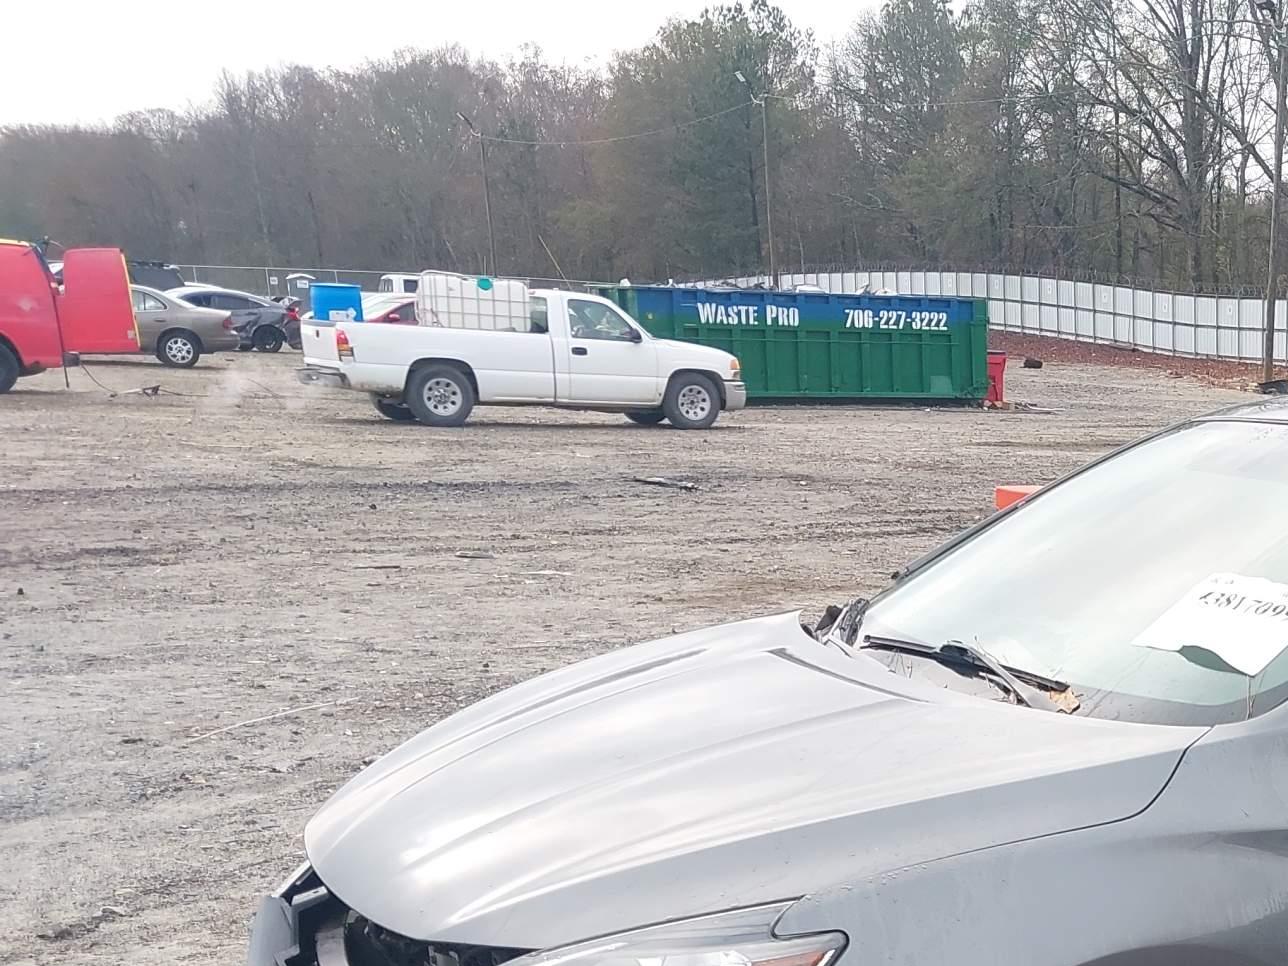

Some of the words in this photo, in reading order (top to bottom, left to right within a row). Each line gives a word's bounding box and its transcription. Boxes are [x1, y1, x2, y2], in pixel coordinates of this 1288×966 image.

[697, 302, 758, 325] WASTE
[765, 304, 800, 327] PRO
[844, 309, 948, 331] 706-227-3222
